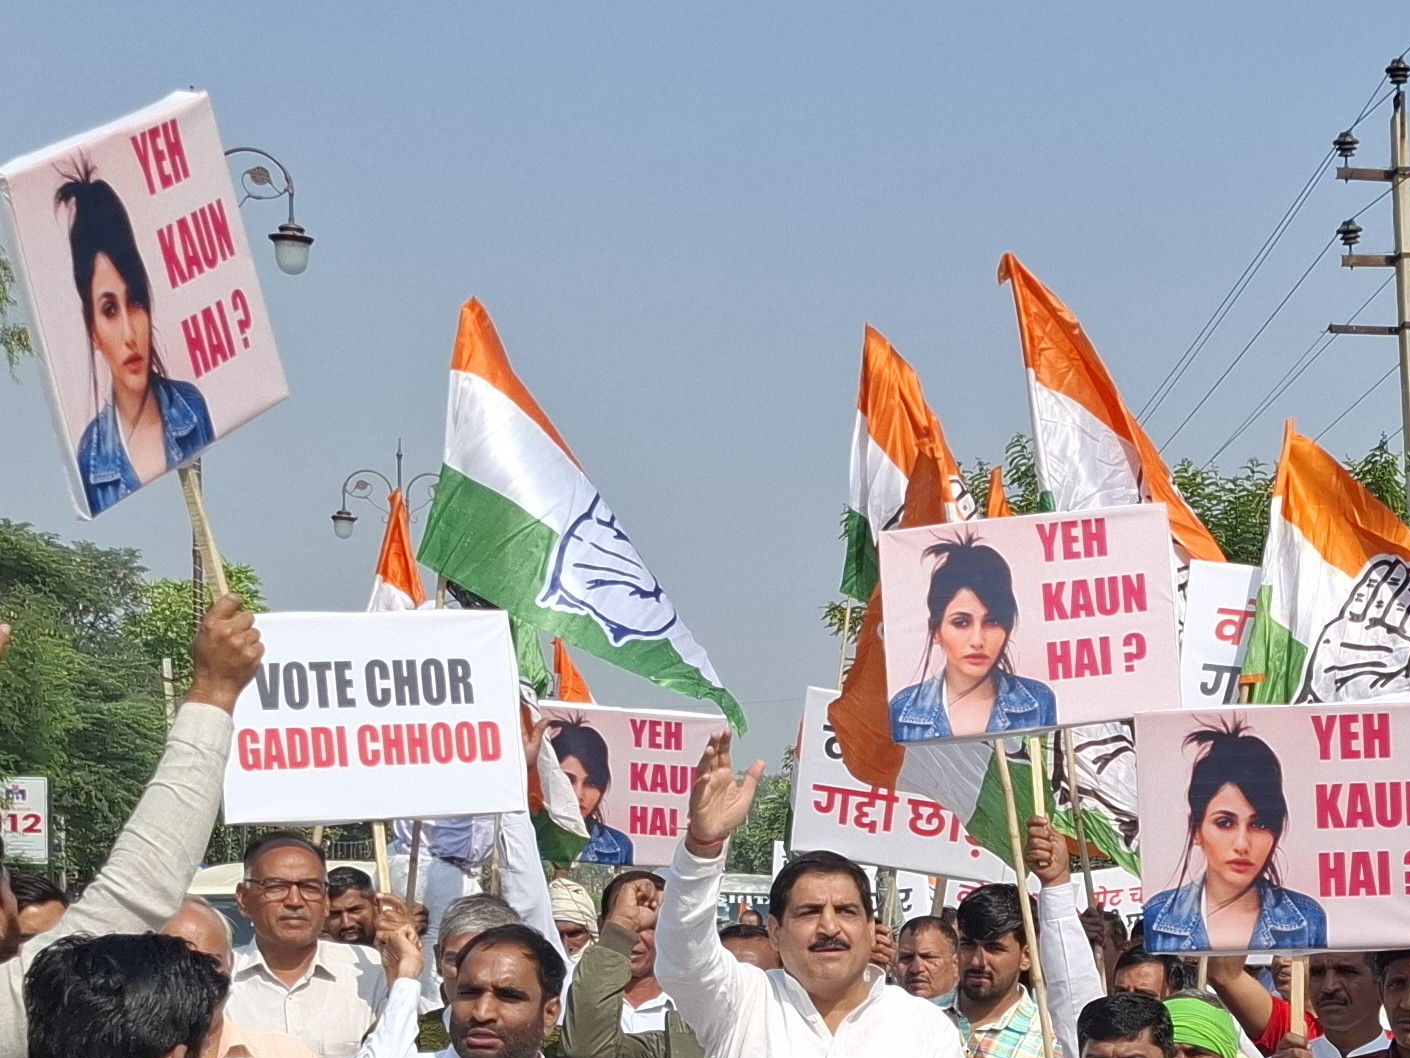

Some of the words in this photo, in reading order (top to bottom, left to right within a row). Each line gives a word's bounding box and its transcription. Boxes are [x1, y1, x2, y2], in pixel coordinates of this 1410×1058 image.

[129, 117, 191, 196] YEH
[156, 198, 236, 289] KAUN
[181, 299, 237, 379] HAI
[231, 288, 252, 350] ?
[1035, 517, 1108, 562] YEH
[1042, 573, 1147, 621] KAUN
[1046, 636, 1112, 681] HAI
[1122, 632, 1147, 673] ?
[255, 660, 357, 710] VOTE
[364, 658, 475, 708] CHOR
[237, 726, 349, 771] GADDI
[357, 721, 501, 767] CHHOOD
[629, 718, 683, 751] YEH
[1310, 713, 1391, 760] YEH
[0, 813, 42, 834] 12
[629, 805, 678, 837] HAI
[1318, 850, 1391, 897] HAI
